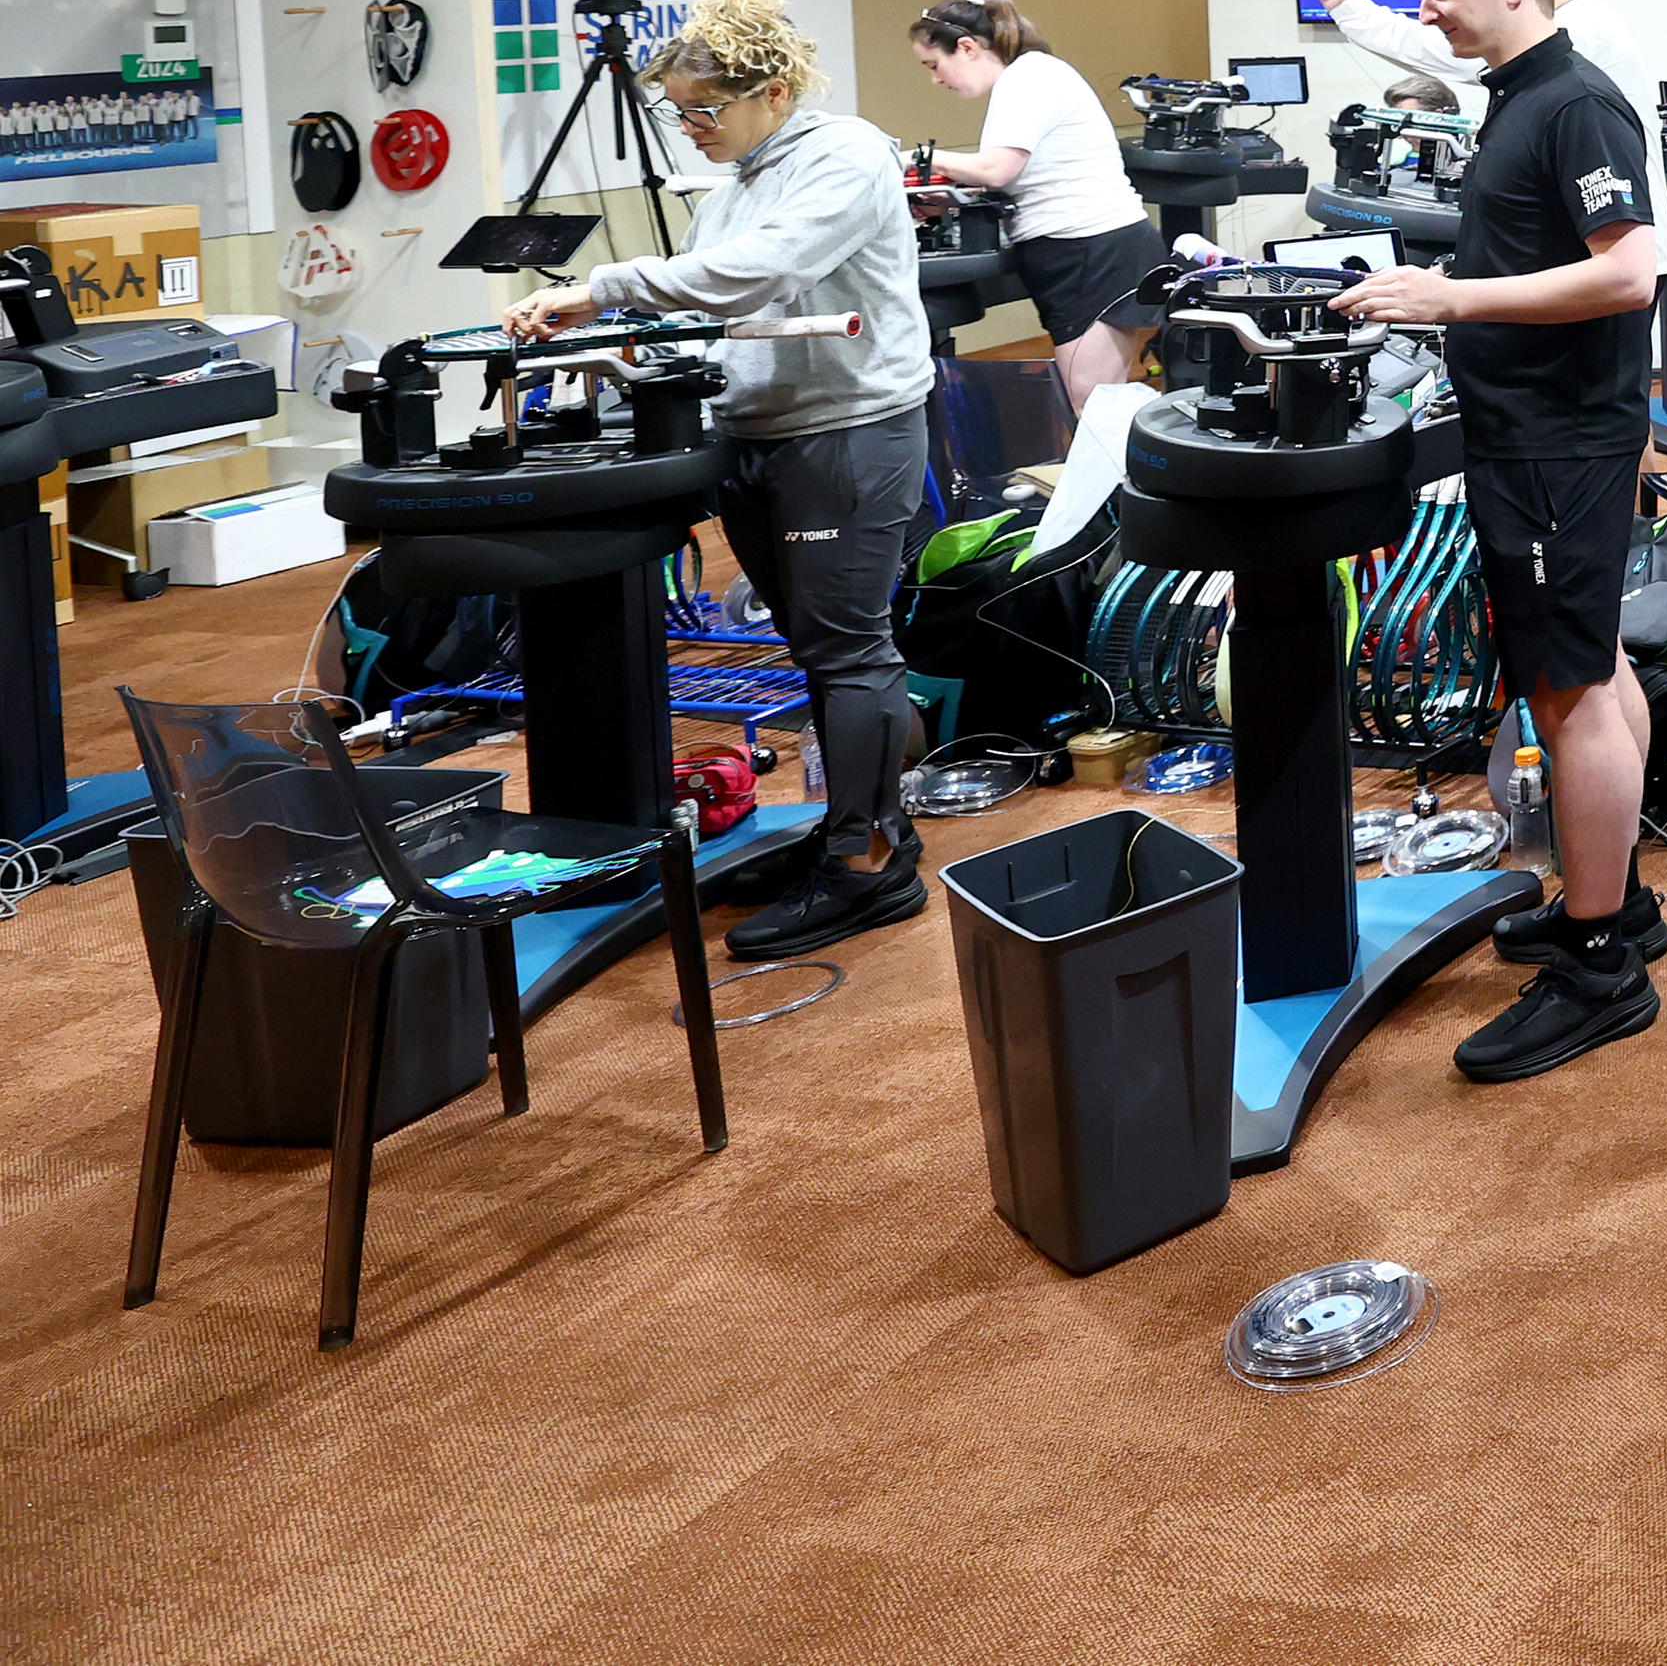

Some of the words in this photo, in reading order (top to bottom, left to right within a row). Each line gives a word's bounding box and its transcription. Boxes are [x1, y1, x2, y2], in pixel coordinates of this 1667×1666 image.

[136, 57, 187, 79] 2024
[15, 144, 154, 165] MELBOURNE
[1575, 166, 1613, 190] YONEX
[1584, 192, 1613, 215] TEAM
[376, 495, 492, 510] PRECISION
[801, 527, 839, 543] YONEX
[1533, 557, 1546, 585] YONEX
